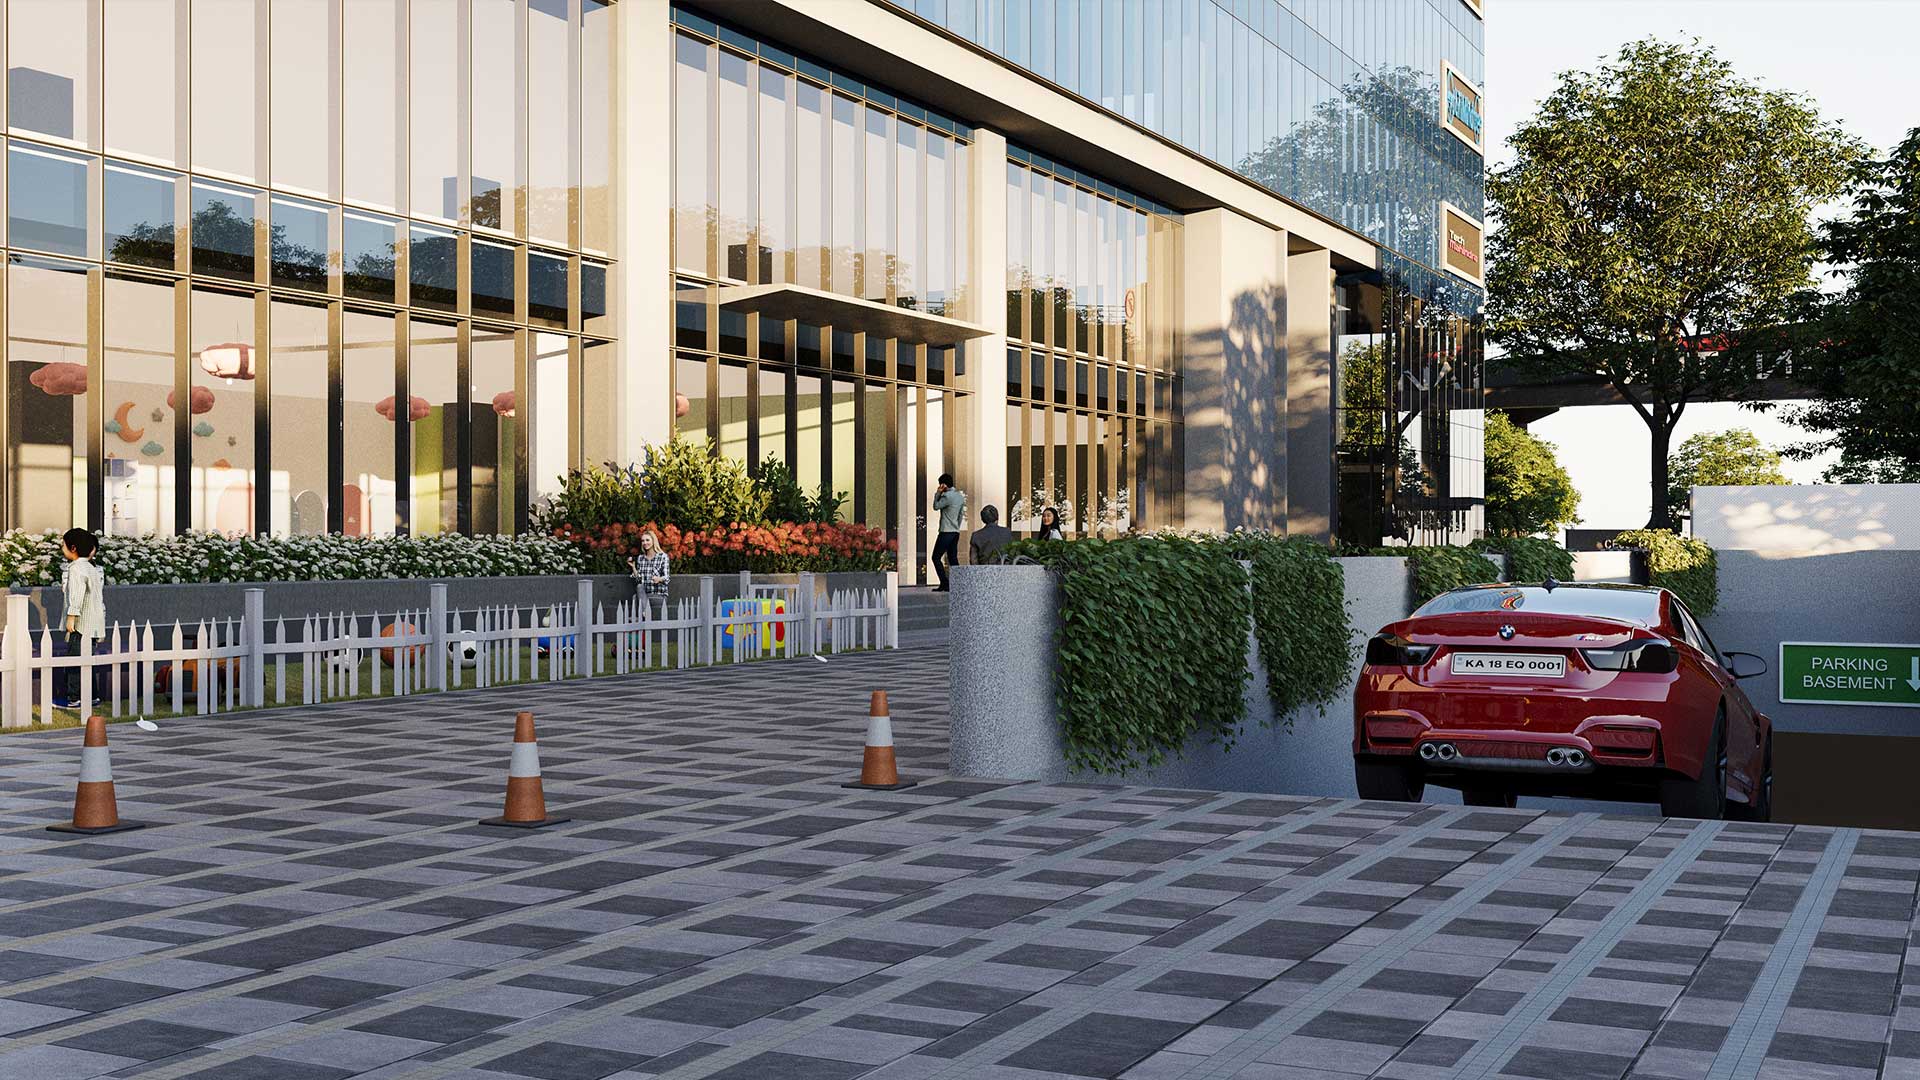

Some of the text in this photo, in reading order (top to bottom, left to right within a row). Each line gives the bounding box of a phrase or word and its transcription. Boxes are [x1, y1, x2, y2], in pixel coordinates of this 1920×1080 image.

[1449, 229, 1465, 246] Tech
[1465, 659, 1561, 670] KA 18 EQ 0001
[1812, 657, 1888, 671] PARKING
[1803, 675, 1897, 690] BASEMENT
